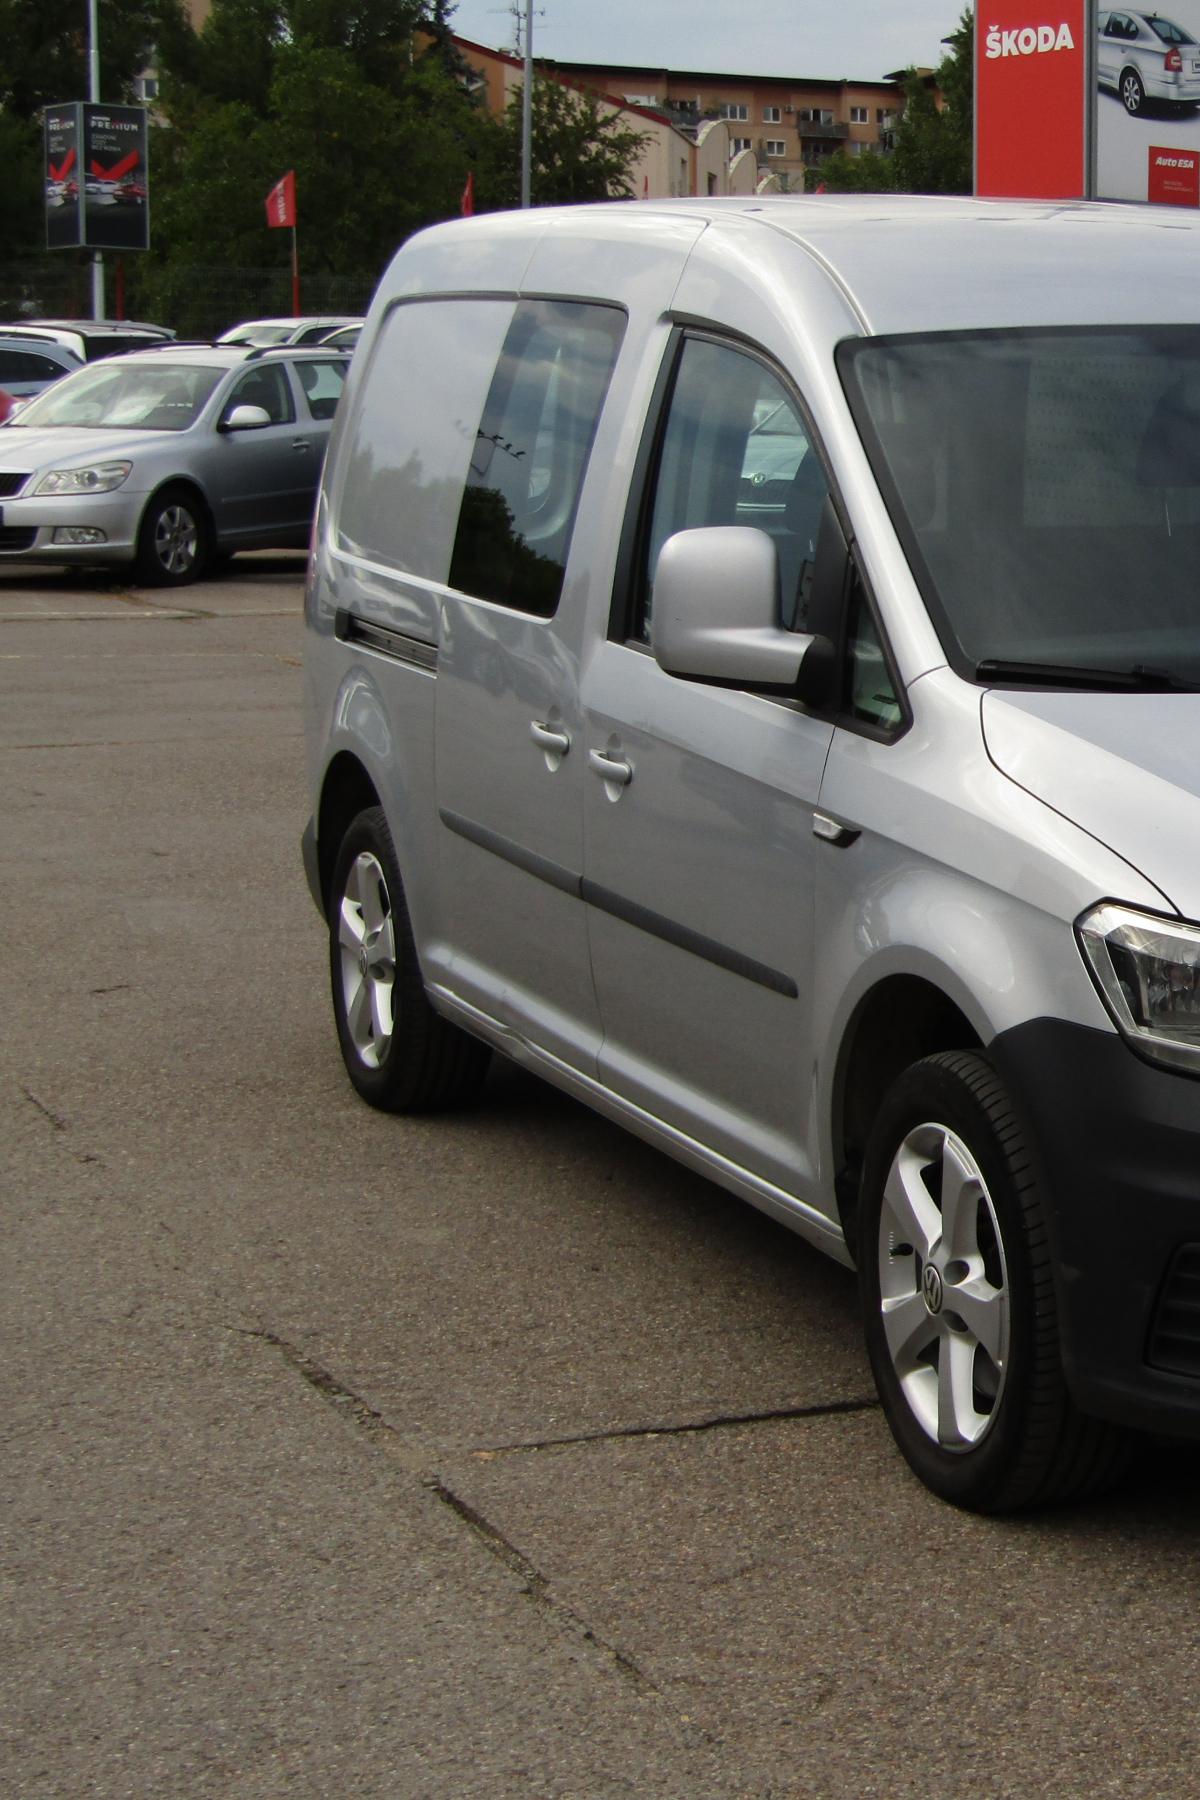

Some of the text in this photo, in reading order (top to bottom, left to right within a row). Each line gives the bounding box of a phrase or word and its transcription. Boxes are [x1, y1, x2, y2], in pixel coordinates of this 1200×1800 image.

[985, 23, 1075, 59] ŠKODA
[1155, 156, 1194, 169] Auto ESA
